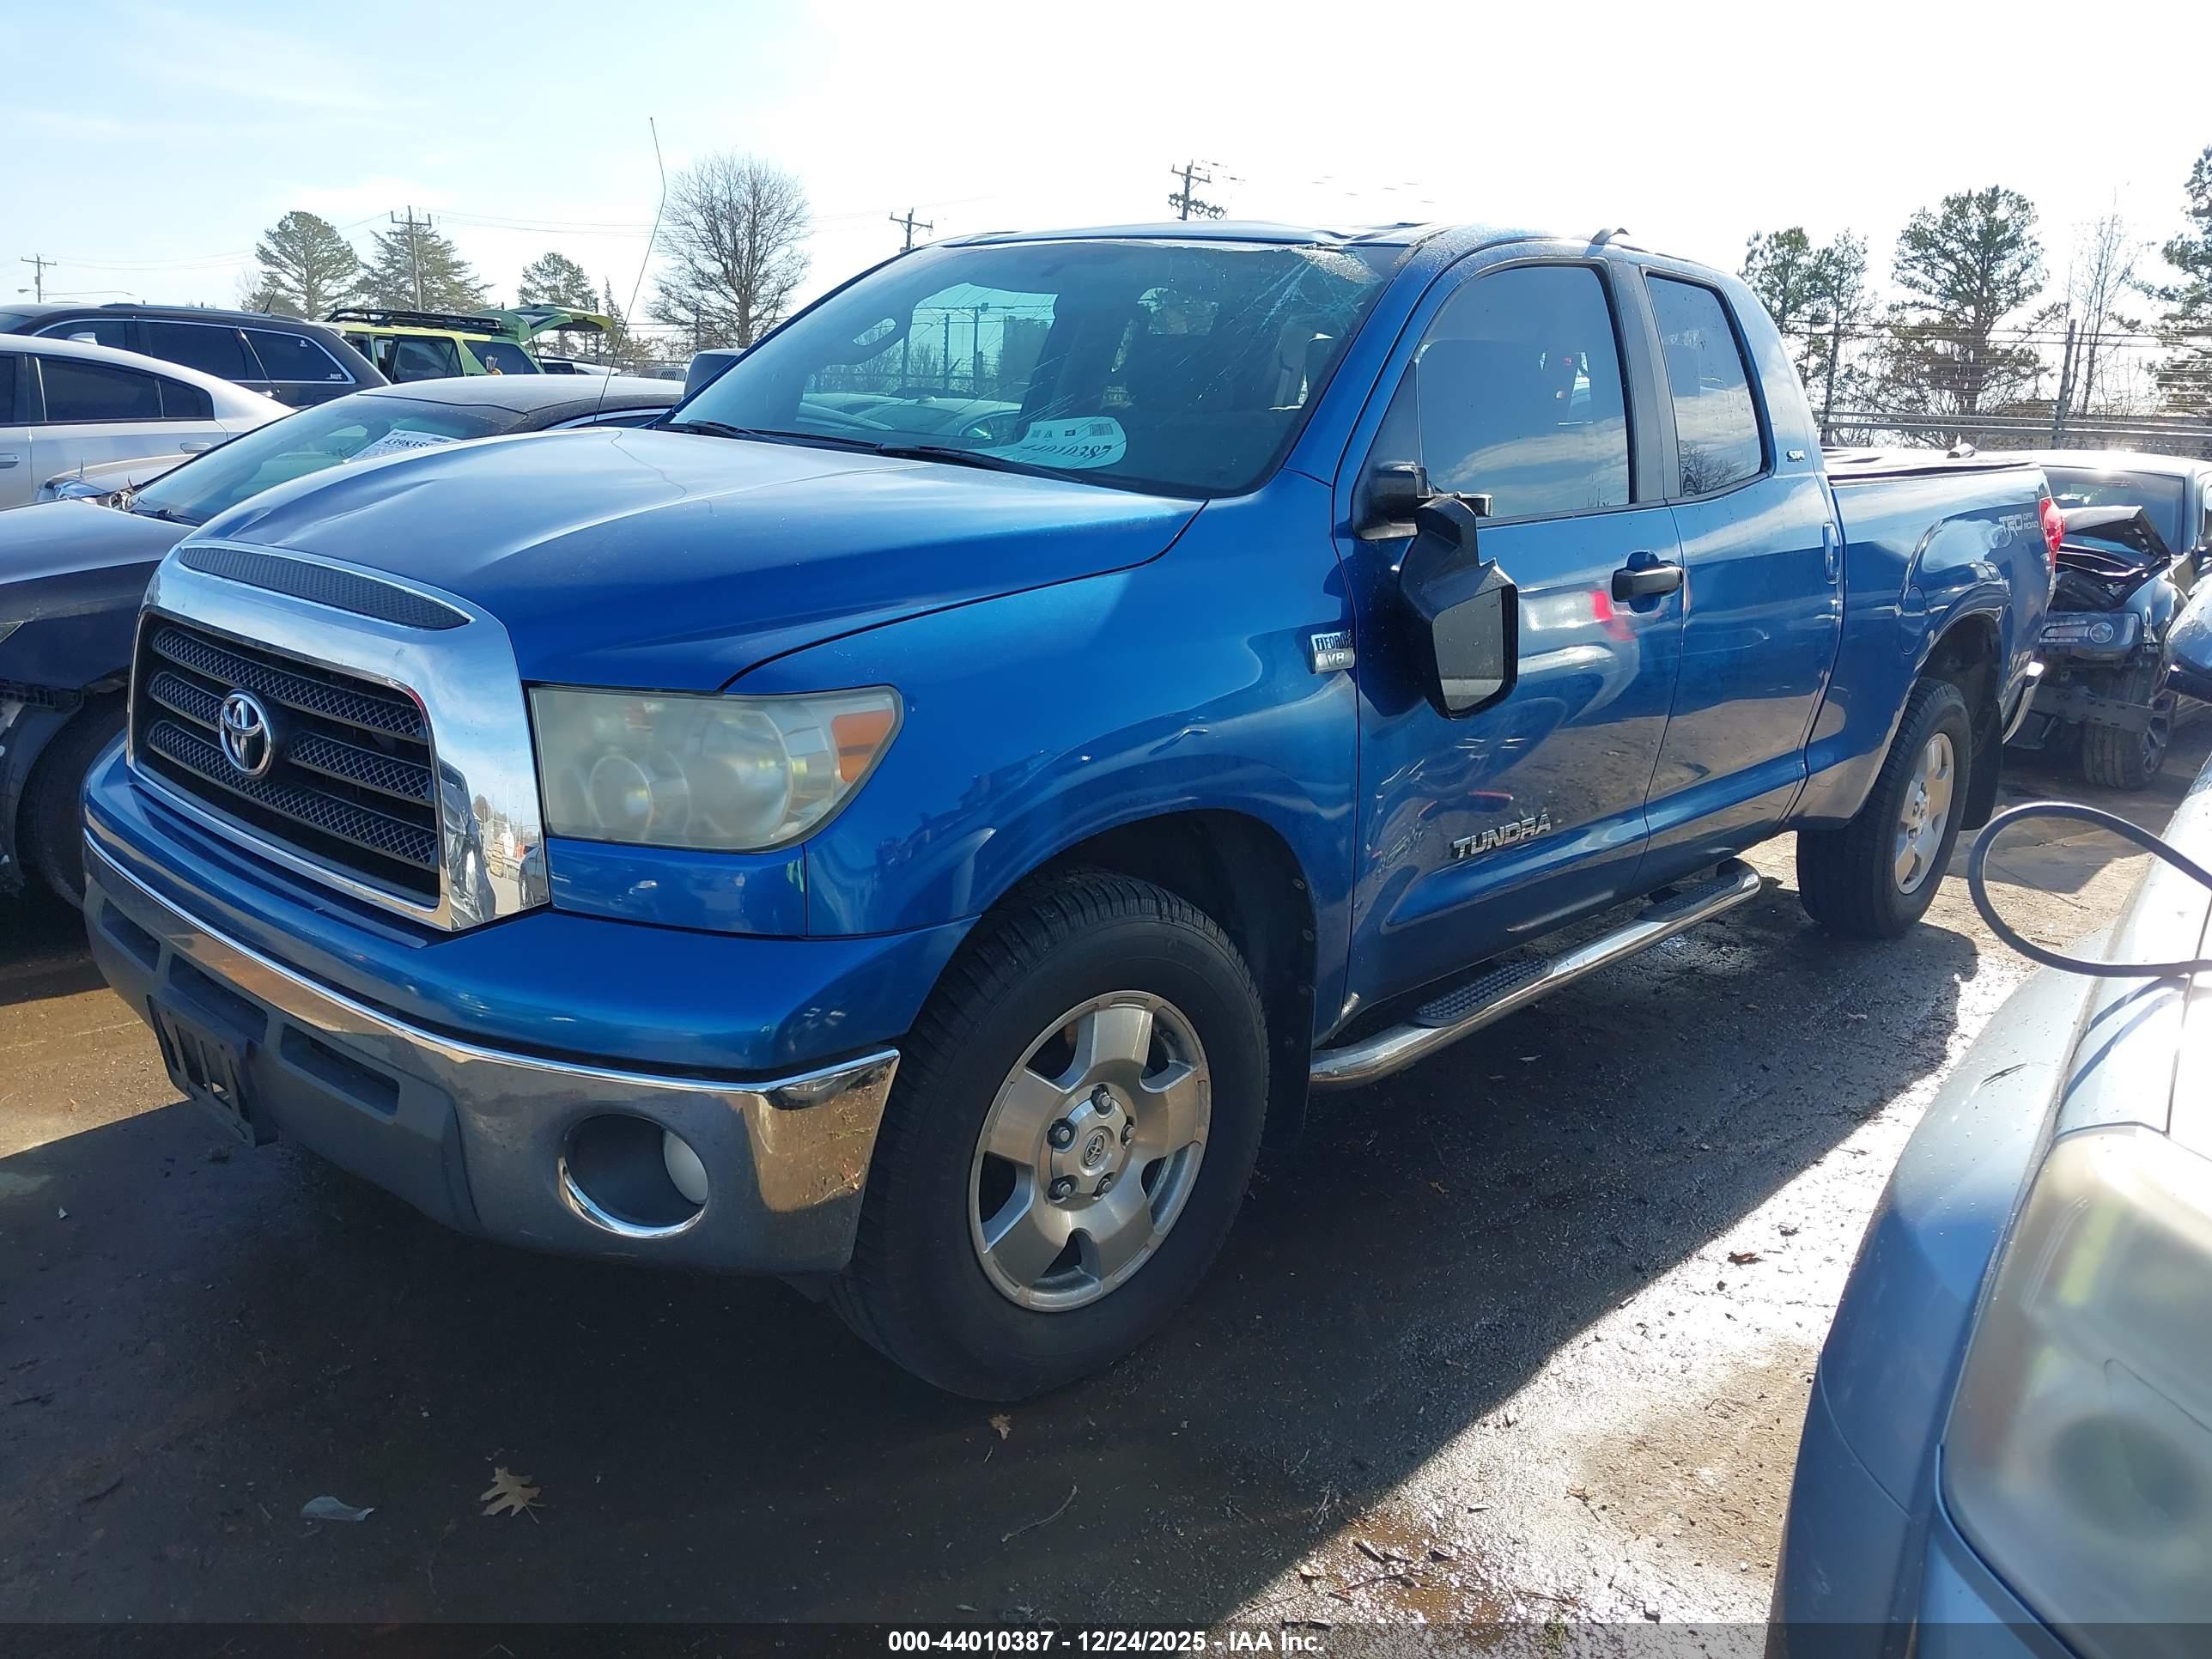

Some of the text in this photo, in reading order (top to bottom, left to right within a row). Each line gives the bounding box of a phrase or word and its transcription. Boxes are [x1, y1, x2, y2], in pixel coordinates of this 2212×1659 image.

[2023, 511, 2035, 520] OFF
[1998, 514, 2024, 538] TRD
[2023, 520, 2039, 530] ROAD
[1326, 653, 1345, 667] V8
[1452, 812, 1553, 860] TUNDRA
